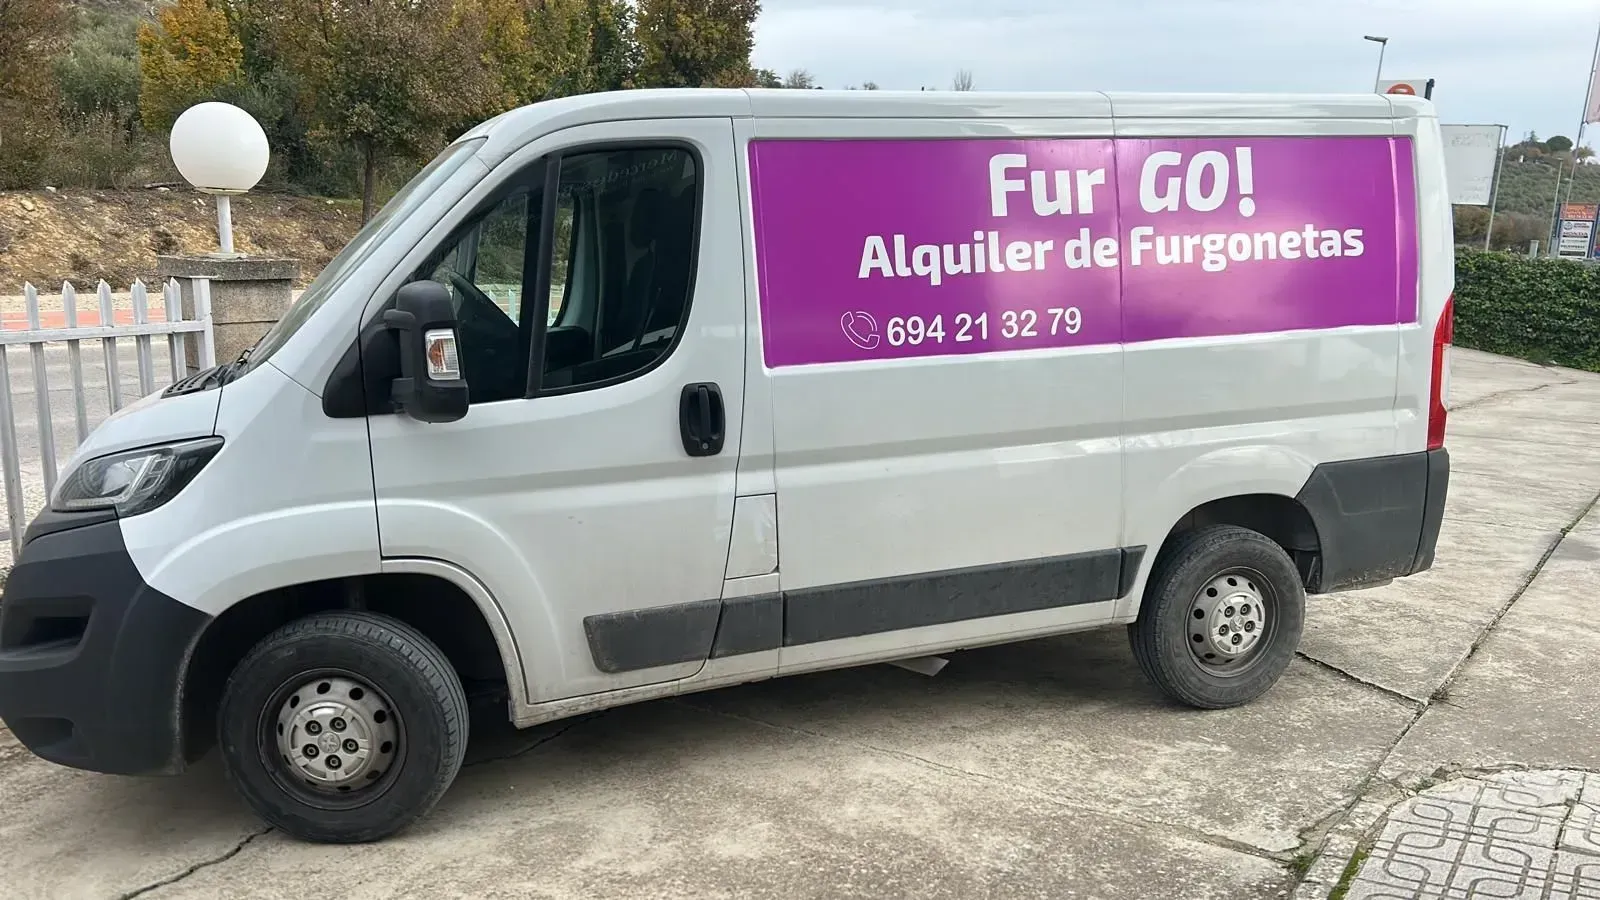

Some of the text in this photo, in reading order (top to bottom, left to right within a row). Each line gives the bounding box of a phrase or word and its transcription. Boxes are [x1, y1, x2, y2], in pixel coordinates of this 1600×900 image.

[989, 147, 1255, 217] Fur GO!
[859, 224, 1364, 285] Alquiler de Furgonetas
[887, 307, 1082, 346] 694 21 32 79
